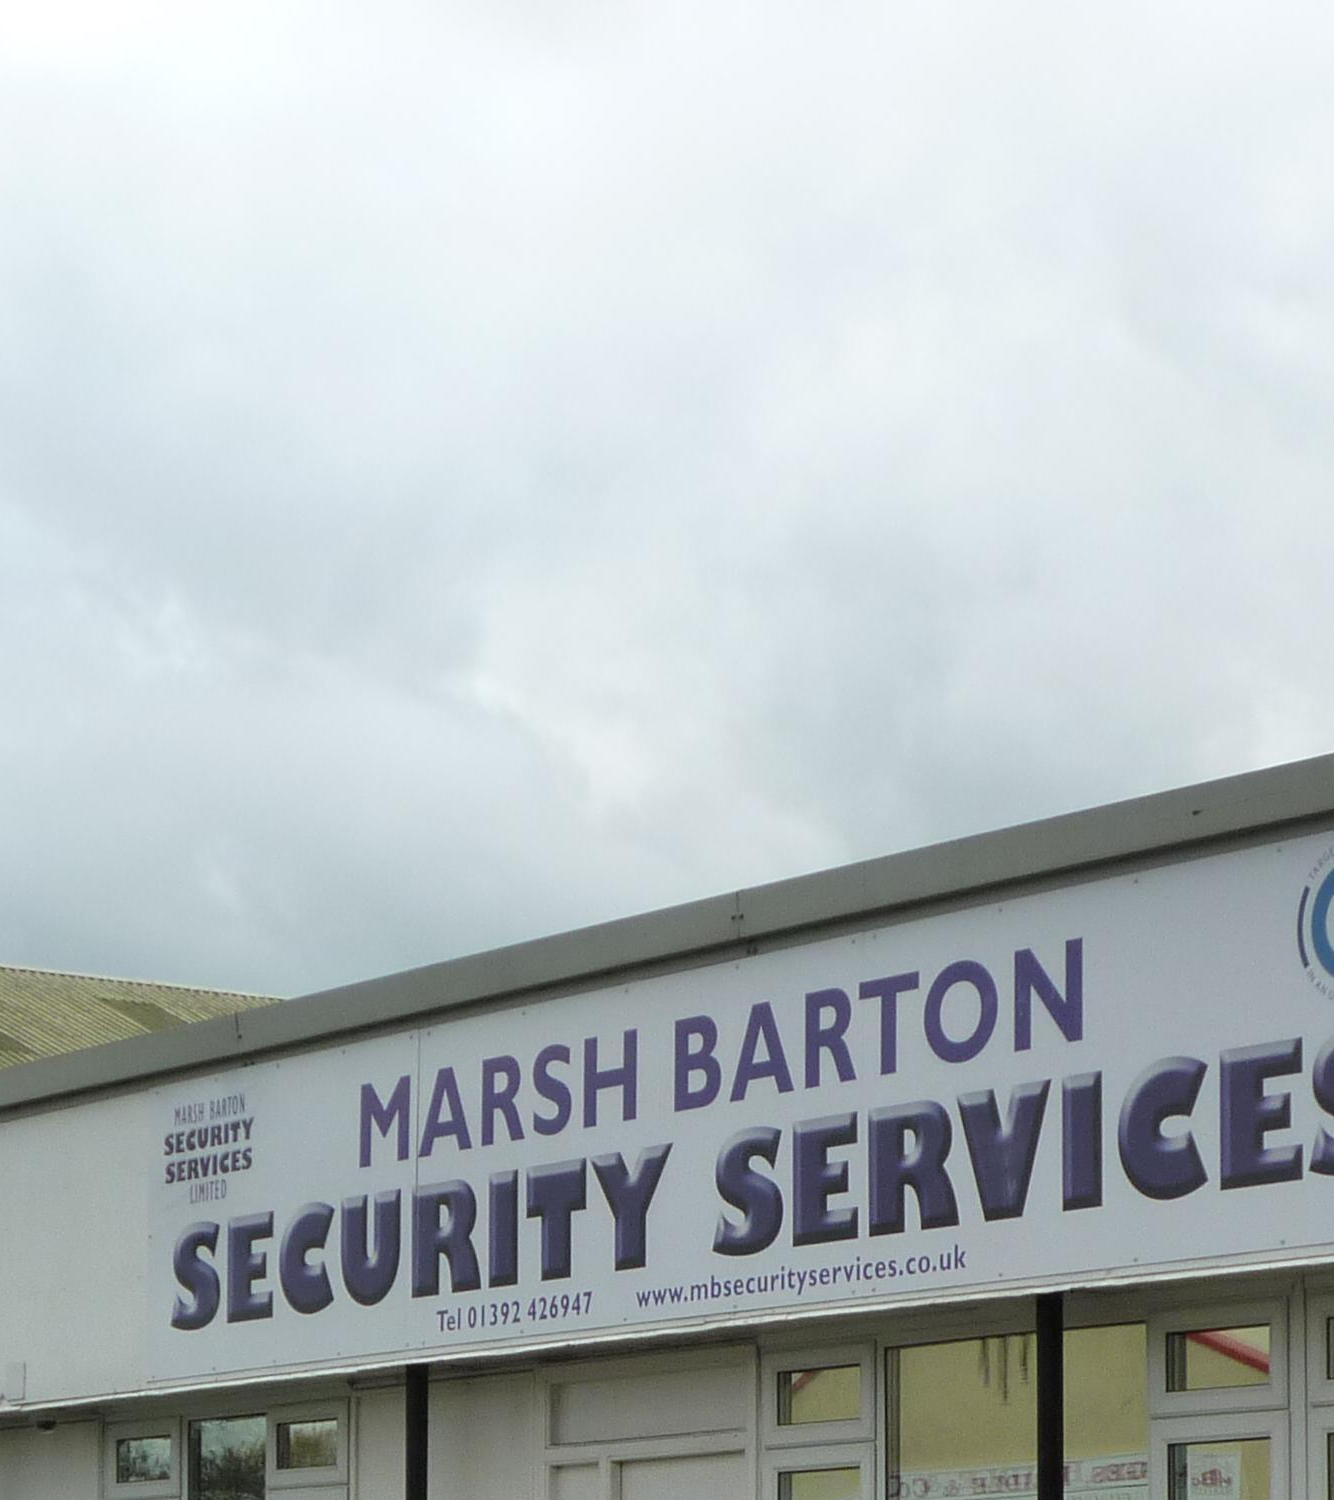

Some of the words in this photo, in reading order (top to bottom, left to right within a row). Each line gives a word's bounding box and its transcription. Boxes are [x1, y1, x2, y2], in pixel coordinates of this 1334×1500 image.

[358, 1029, 639, 1168] MARSH
[674, 937, 1084, 1113] BARTON
[174, 1103, 204, 1125] MARSH
[210, 1094, 245, 1120] BARTON
[164, 1116, 255, 1156] SECURITY
[165, 1147, 252, 1184] SERVICES
[190, 1179, 227, 1204] LIMITED
[170, 1142, 673, 1331] SECURITY
[636, 1244, 966, 1308] www.mbsecurityservices.co.uk
[437, 1308, 462, 1333] Tel
[467, 1299, 522, 1328] 01392
[527, 1291, 594, 1321] 426947
